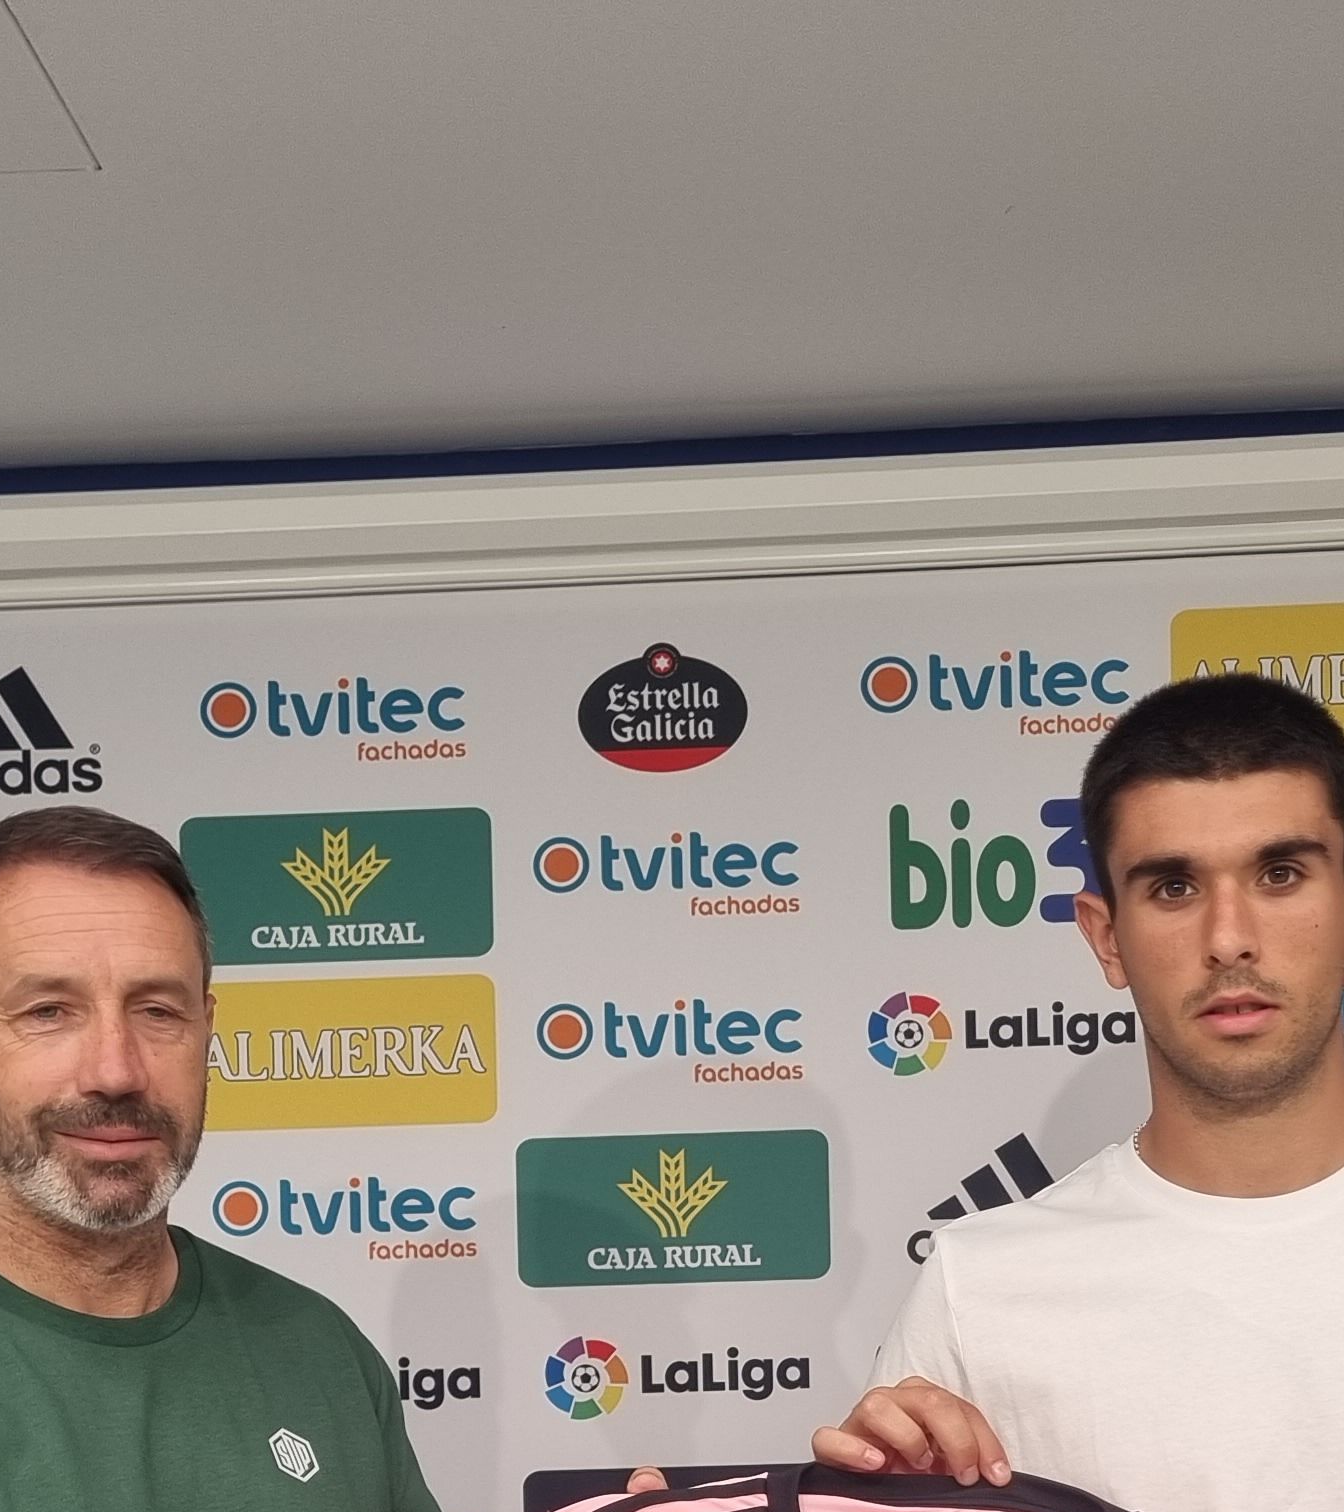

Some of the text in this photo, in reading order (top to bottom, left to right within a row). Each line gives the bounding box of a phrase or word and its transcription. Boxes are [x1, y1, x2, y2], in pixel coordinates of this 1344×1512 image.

[267, 676, 466, 737] tvitec
[605, 681, 719, 713] Estrella
[928, 650, 1129, 712] tvitec
[357, 739, 467, 762] fachadas
[610, 713, 714, 746] Galicia
[599, 831, 800, 891] tvitec
[889, 798, 1105, 930] bio3
[690, 894, 800, 916] fachadas
[251, 921, 425, 949] CAJA RURAL
[604, 998, 803, 1059] tvitec
[965, 999, 1137, 1054] LaLiga
[206, 1023, 486, 1083] ALIMERKA
[693, 1061, 804, 1084] fachadas
[281, 1176, 476, 1236] tvitec
[368, 1238, 477, 1261] fachadas
[588, 1243, 761, 1271] CAJA RURAL
[641, 1347, 810, 1399] LaLiga
